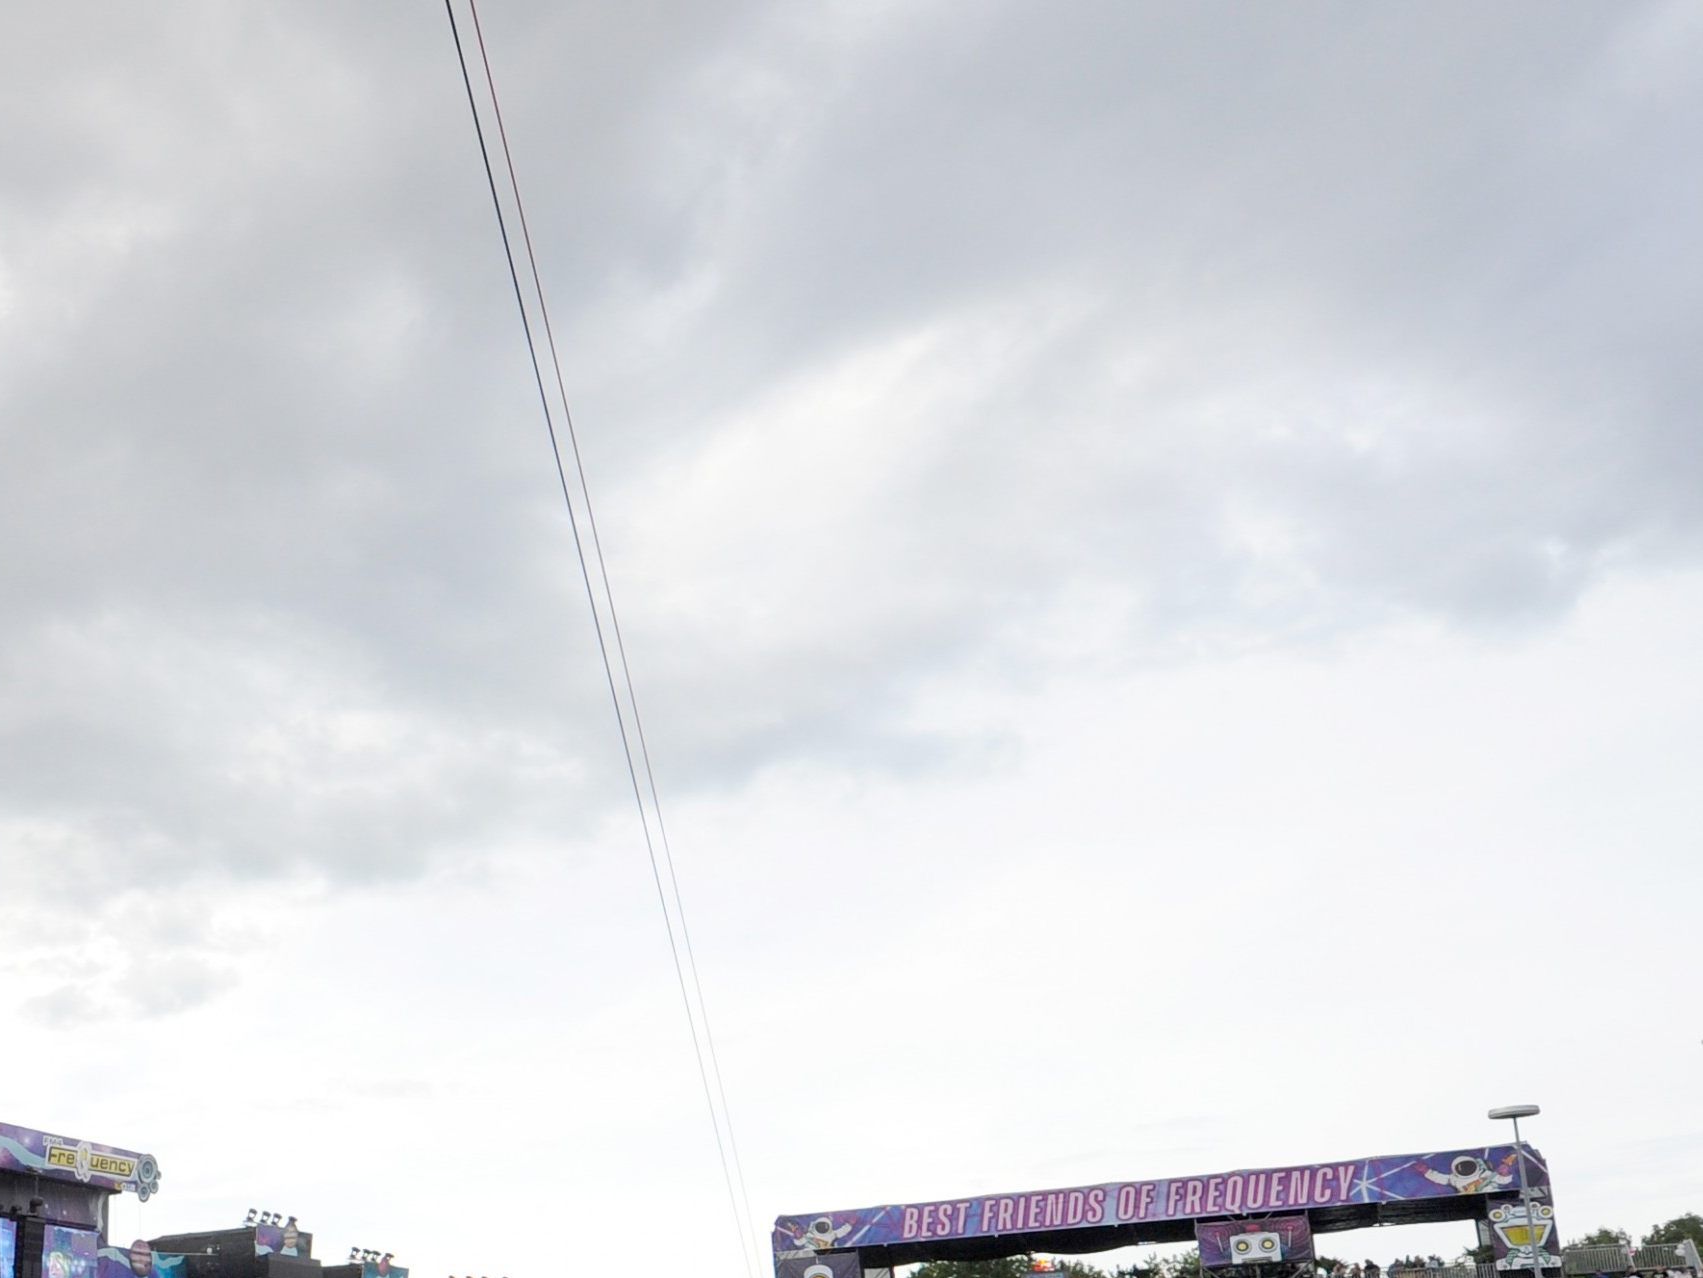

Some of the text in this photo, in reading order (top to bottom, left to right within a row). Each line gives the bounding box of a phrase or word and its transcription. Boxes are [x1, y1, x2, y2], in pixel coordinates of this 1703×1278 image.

[902, 1164, 1356, 1239] BEST FRIENDS OF FREQUENCY
